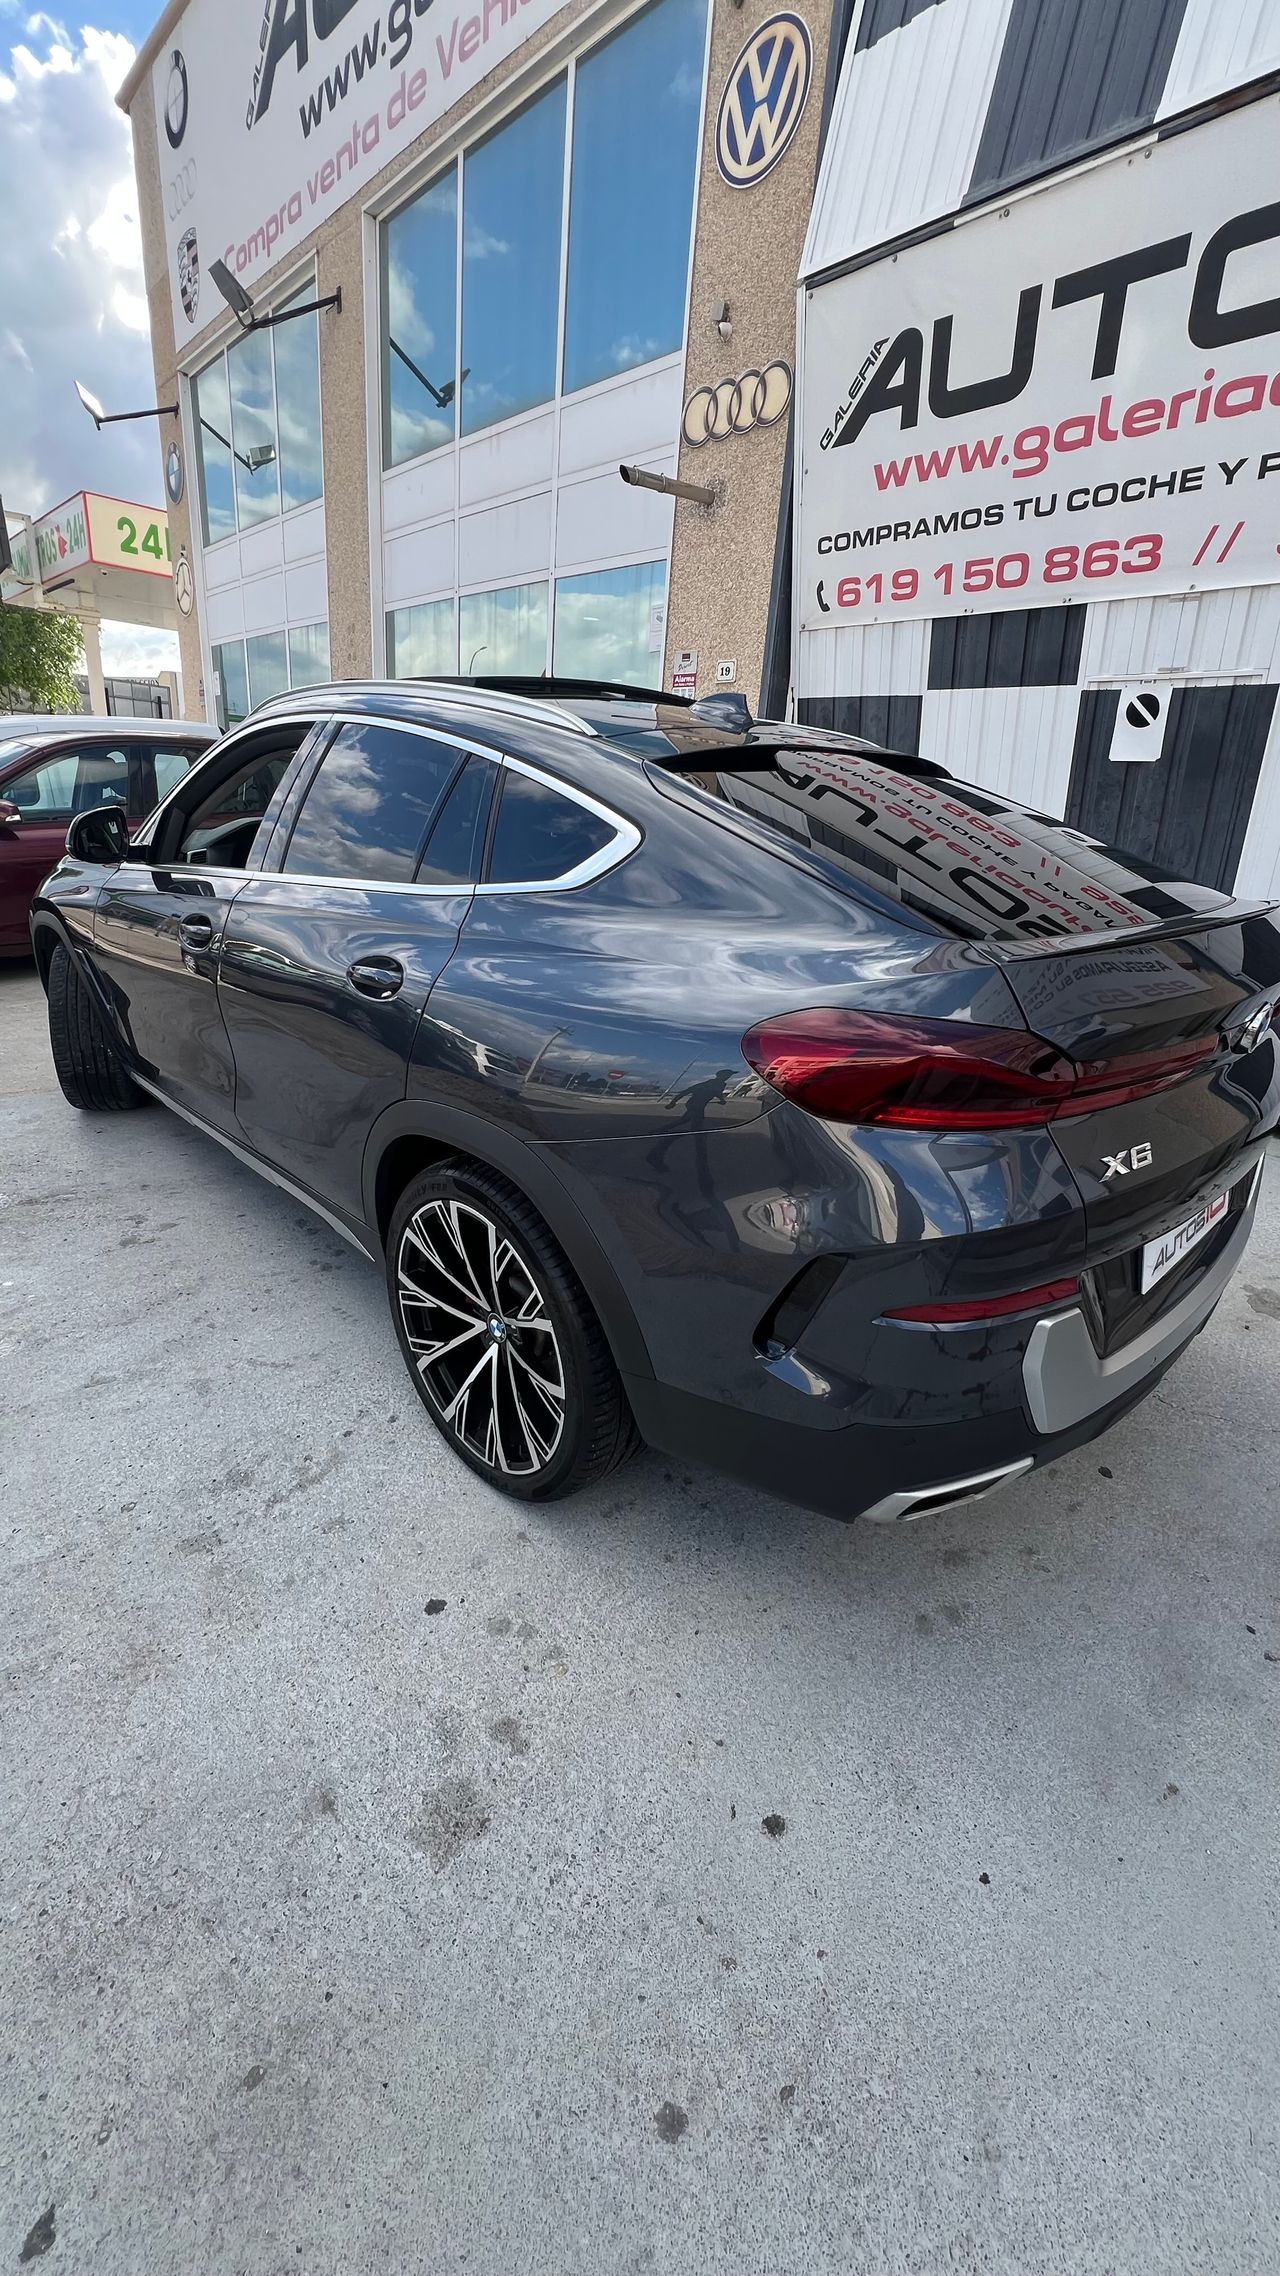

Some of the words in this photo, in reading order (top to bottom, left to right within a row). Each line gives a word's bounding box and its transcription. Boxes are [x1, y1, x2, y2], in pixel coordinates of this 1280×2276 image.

[224, 190, 302, 276] Compra
[306, 112, 379, 205] venta
[387, 68, 427, 130] de
[819, 336, 891, 451] GALERIA
[873, 368, 1280, 491] www.galeria
[66, 511, 86, 554] 24H
[817, 503, 1004, 555] COMPRAMOS
[1013, 493, 1058, 522] TU
[1066, 466, 1206, 512] COCHE
[1217, 456, 1250, 486] Y
[836, 568, 919, 608] 619
[933, 552, 1030, 597] 150
[1042, 533, 1163, 584] 863
[674, 674, 695, 683] Alarma
[719, 666, 731, 677] 19
[1099, 1142, 1153, 1183] X6
